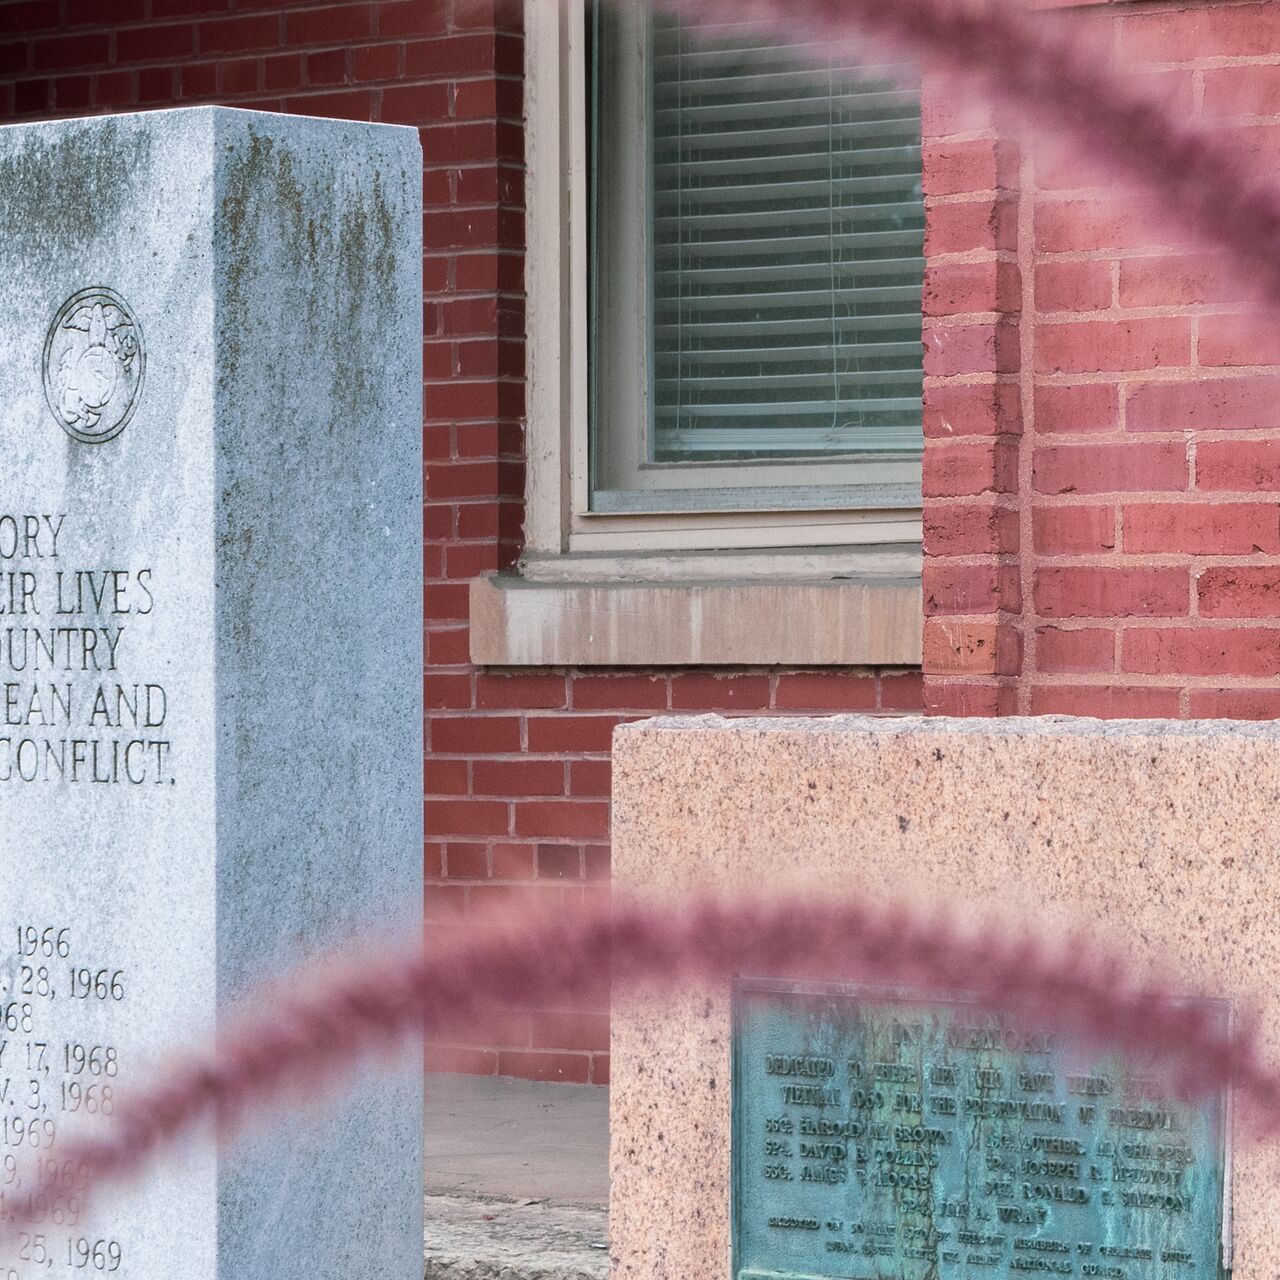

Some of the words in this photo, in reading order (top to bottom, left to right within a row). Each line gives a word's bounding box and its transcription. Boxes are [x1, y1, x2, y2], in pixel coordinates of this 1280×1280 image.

[55, 569, 155, 616] LIVES
[91, 684, 167, 729] AND
[18, 925, 71, 958] 1966
[21, 966, 56, 999] 28,
[70, 968, 125, 1001] 1966
[26, 1042, 50, 1075] 17,
[64, 1043, 119, 1077] 1968
[28, 1080, 46, 1113] 3,
[61, 1082, 114, 1116] 1968
[4, 1115, 57, 1149] 1969
[799, 1117, 863, 1138] HAROLD
[38, 1156, 90, 1192] 1969
[29, 1191, 81, 1227] 1969
[20, 1232, 53, 1267] 25,
[68, 1237, 121, 1272] 1969
